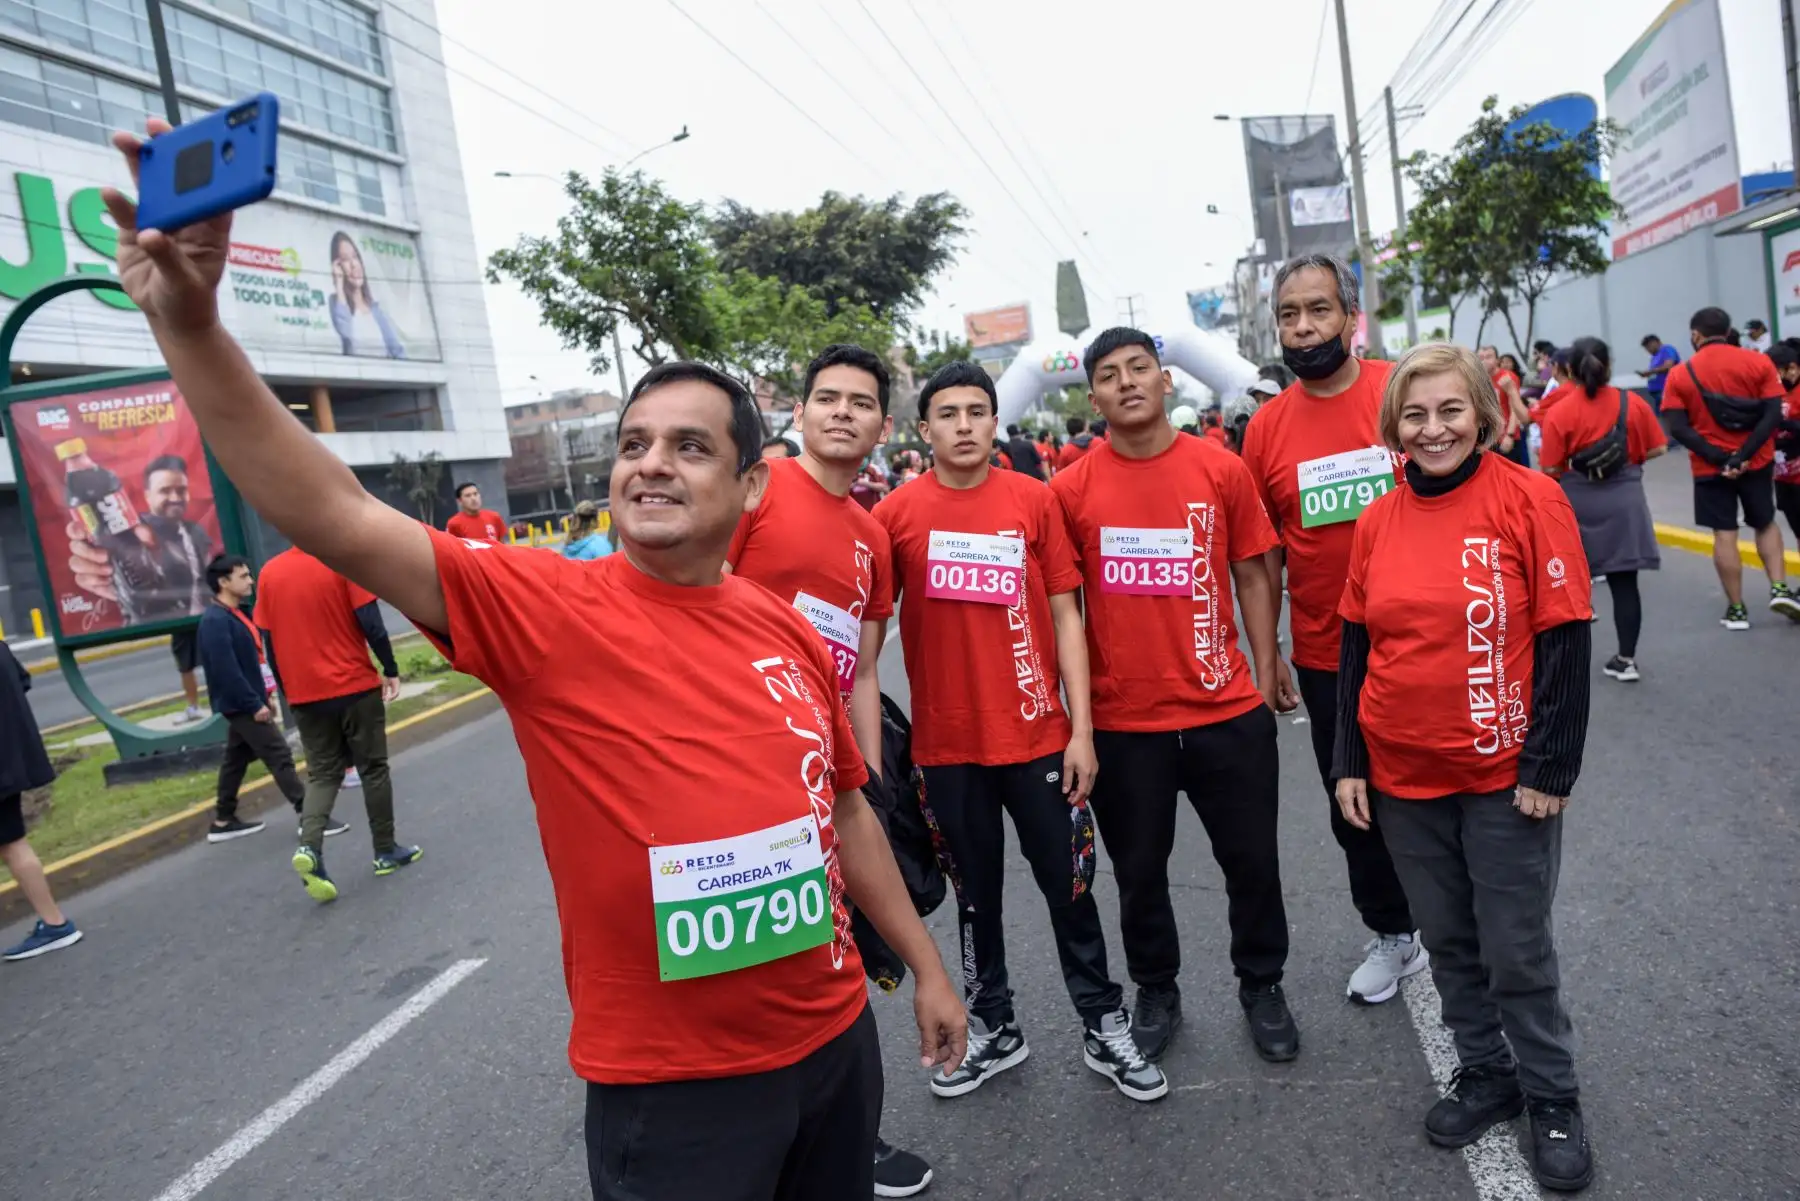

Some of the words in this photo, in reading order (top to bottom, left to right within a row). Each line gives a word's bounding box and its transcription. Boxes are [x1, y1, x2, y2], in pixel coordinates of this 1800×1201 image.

[230, 271, 265, 288] TODOS
[233, 287, 272, 307] TODO
[274, 293, 290, 308] EL
[78, 392, 173, 412] COMPARTIR
[97, 402, 176, 431] REFRESCA
[1317, 469, 1358, 483] CARRERA
[1358, 466, 1371, 475] 7K
[1304, 478, 1388, 516] 00791
[1187, 502, 1208, 535] 21
[854, 539, 869, 574] 21
[946, 540, 971, 548] RETOS
[949, 551, 990, 562] CARRERA
[990, 554, 1002, 563] 7K
[1120, 547, 1160, 555] CARRERA
[1461, 537, 1489, 569] 21
[1491, 538, 1501, 570] SOCIAL
[930, 564, 1017, 595] 00136
[1104, 560, 1189, 586] 00135
[810, 607, 834, 621] RETOS
[1493, 573, 1507, 632] INNOVACIÓN
[811, 621, 845, 640] CARRERA
[1497, 633, 1506, 646] DE
[1462, 577, 1500, 755] CABILDOS
[751, 656, 803, 704] 21
[685, 851, 736, 869] RETOS
[697, 865, 773, 892] CARRERA
[774, 858, 793, 874] 7K
[666, 879, 825, 957] 00790
